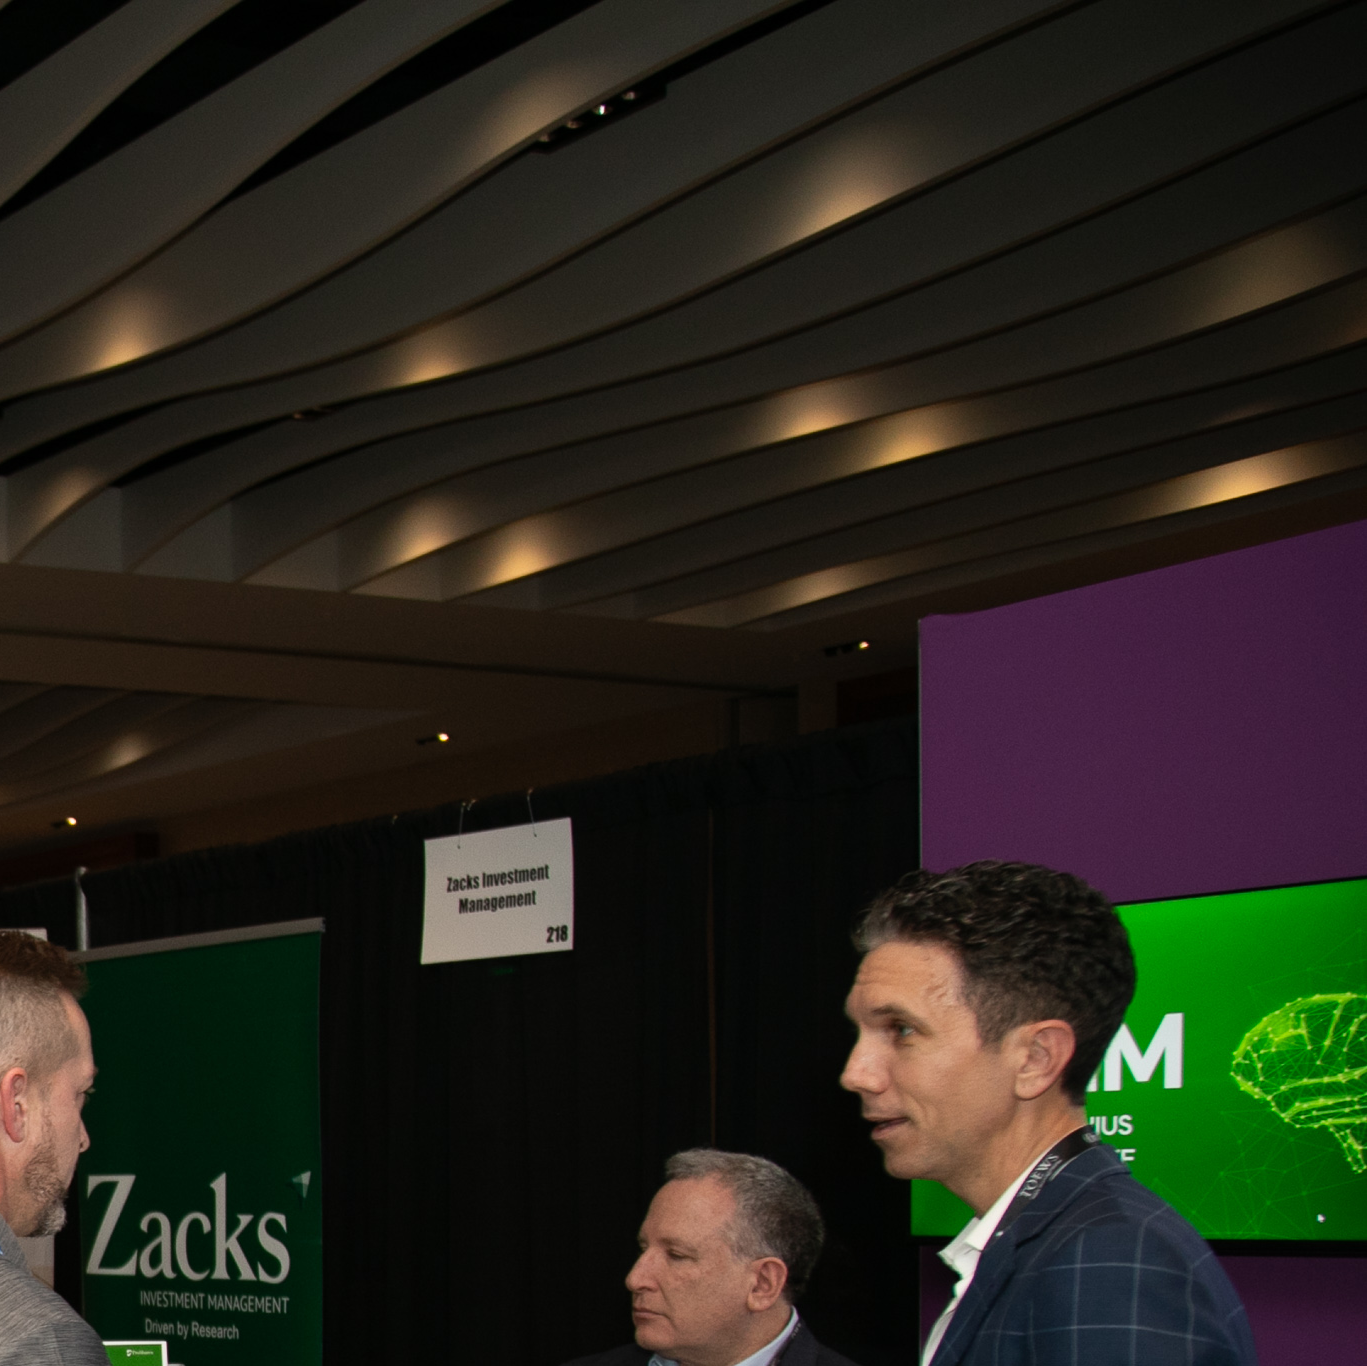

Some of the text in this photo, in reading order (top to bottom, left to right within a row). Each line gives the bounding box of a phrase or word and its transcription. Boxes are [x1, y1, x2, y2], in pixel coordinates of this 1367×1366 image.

[446, 864, 550, 893] Zacks Investment
[458, 890, 536, 914] Management
[546, 925, 569, 943] 218
[1085, 1012, 1185, 1093] M
[1019, 1153, 1060, 1199] TOEWS
[85, 1171, 291, 1285] Zacks
[140, 1290, 290, 1314] INVESTMENT MANAGEMENT
[145, 1317, 240, 1340] Driven by Research
